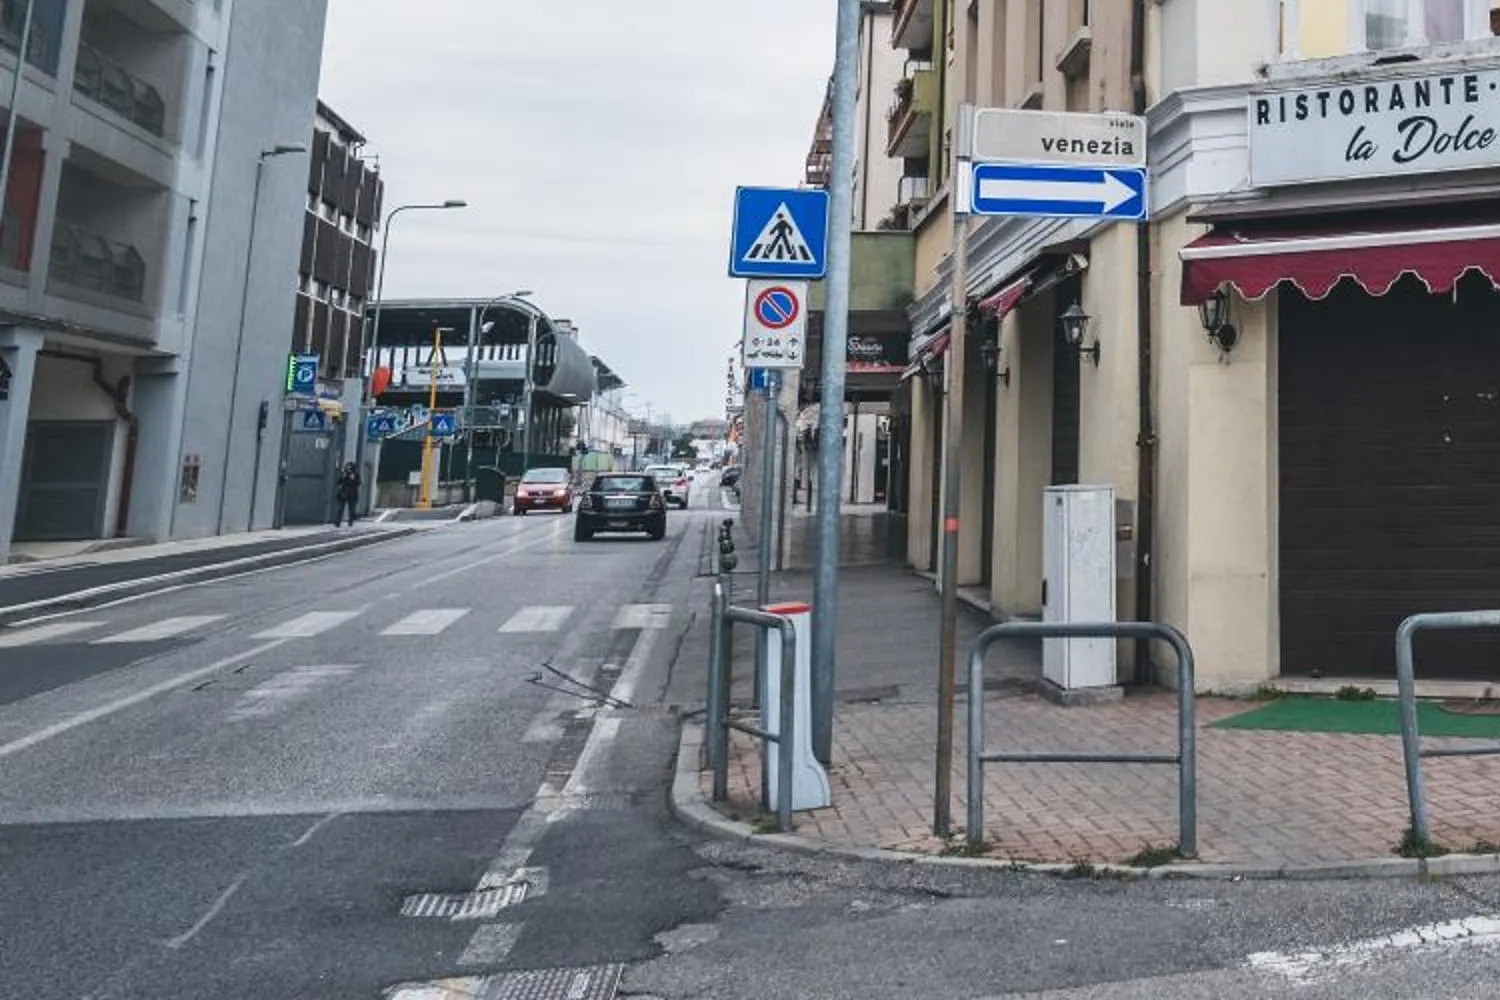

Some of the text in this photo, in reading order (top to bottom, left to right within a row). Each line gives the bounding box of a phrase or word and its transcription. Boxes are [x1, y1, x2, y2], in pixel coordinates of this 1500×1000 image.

[1256, 75, 1479, 125] RISTORANTE
[1041, 136, 1134, 155] venezia
[1345, 125, 1378, 163] la
[1392, 114, 1498, 164] Dolce
